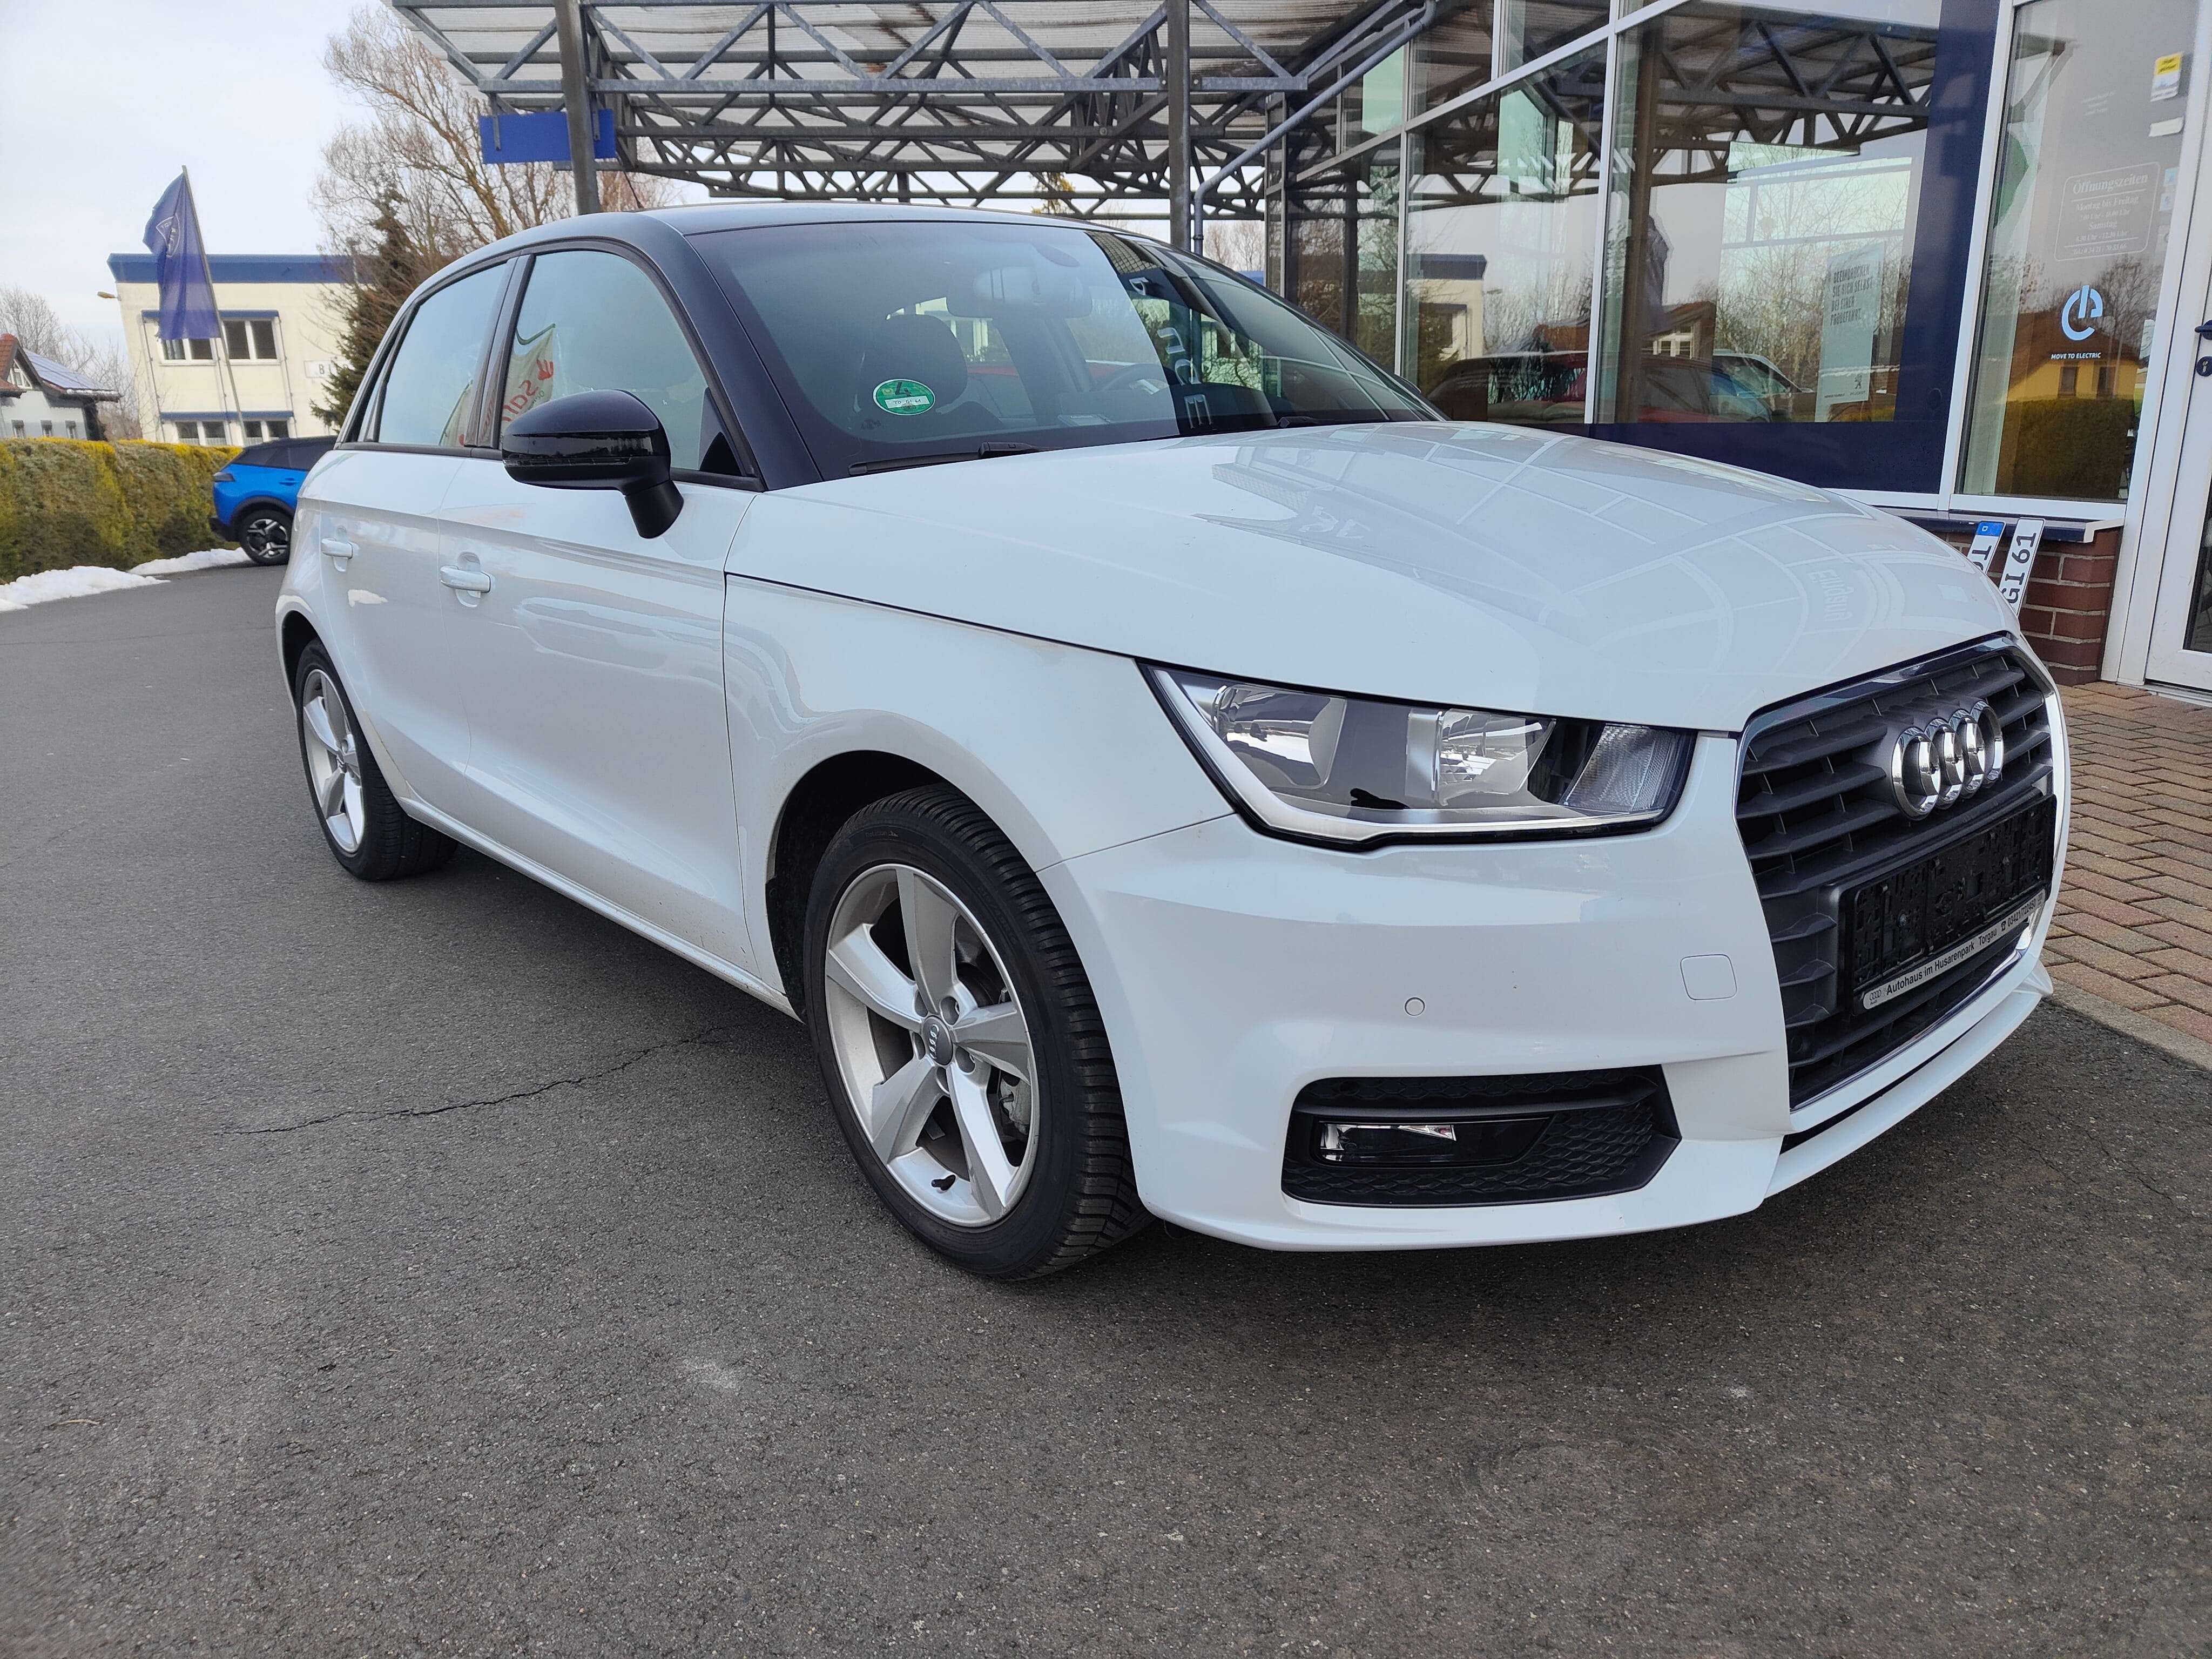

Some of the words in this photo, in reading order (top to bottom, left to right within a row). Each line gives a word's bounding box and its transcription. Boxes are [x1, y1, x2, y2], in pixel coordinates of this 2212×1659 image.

[2073, 173, 2148, 194] Öffnungszeiten
[894, 381, 912, 397] 4
[2011, 532, 2037, 564] 61
[1886, 971, 1923, 996] Autohaus
[1924, 966, 1934, 978] im
[1934, 941, 1975, 972] Husarenpark
[1978, 928, 1997, 947] Torgau
